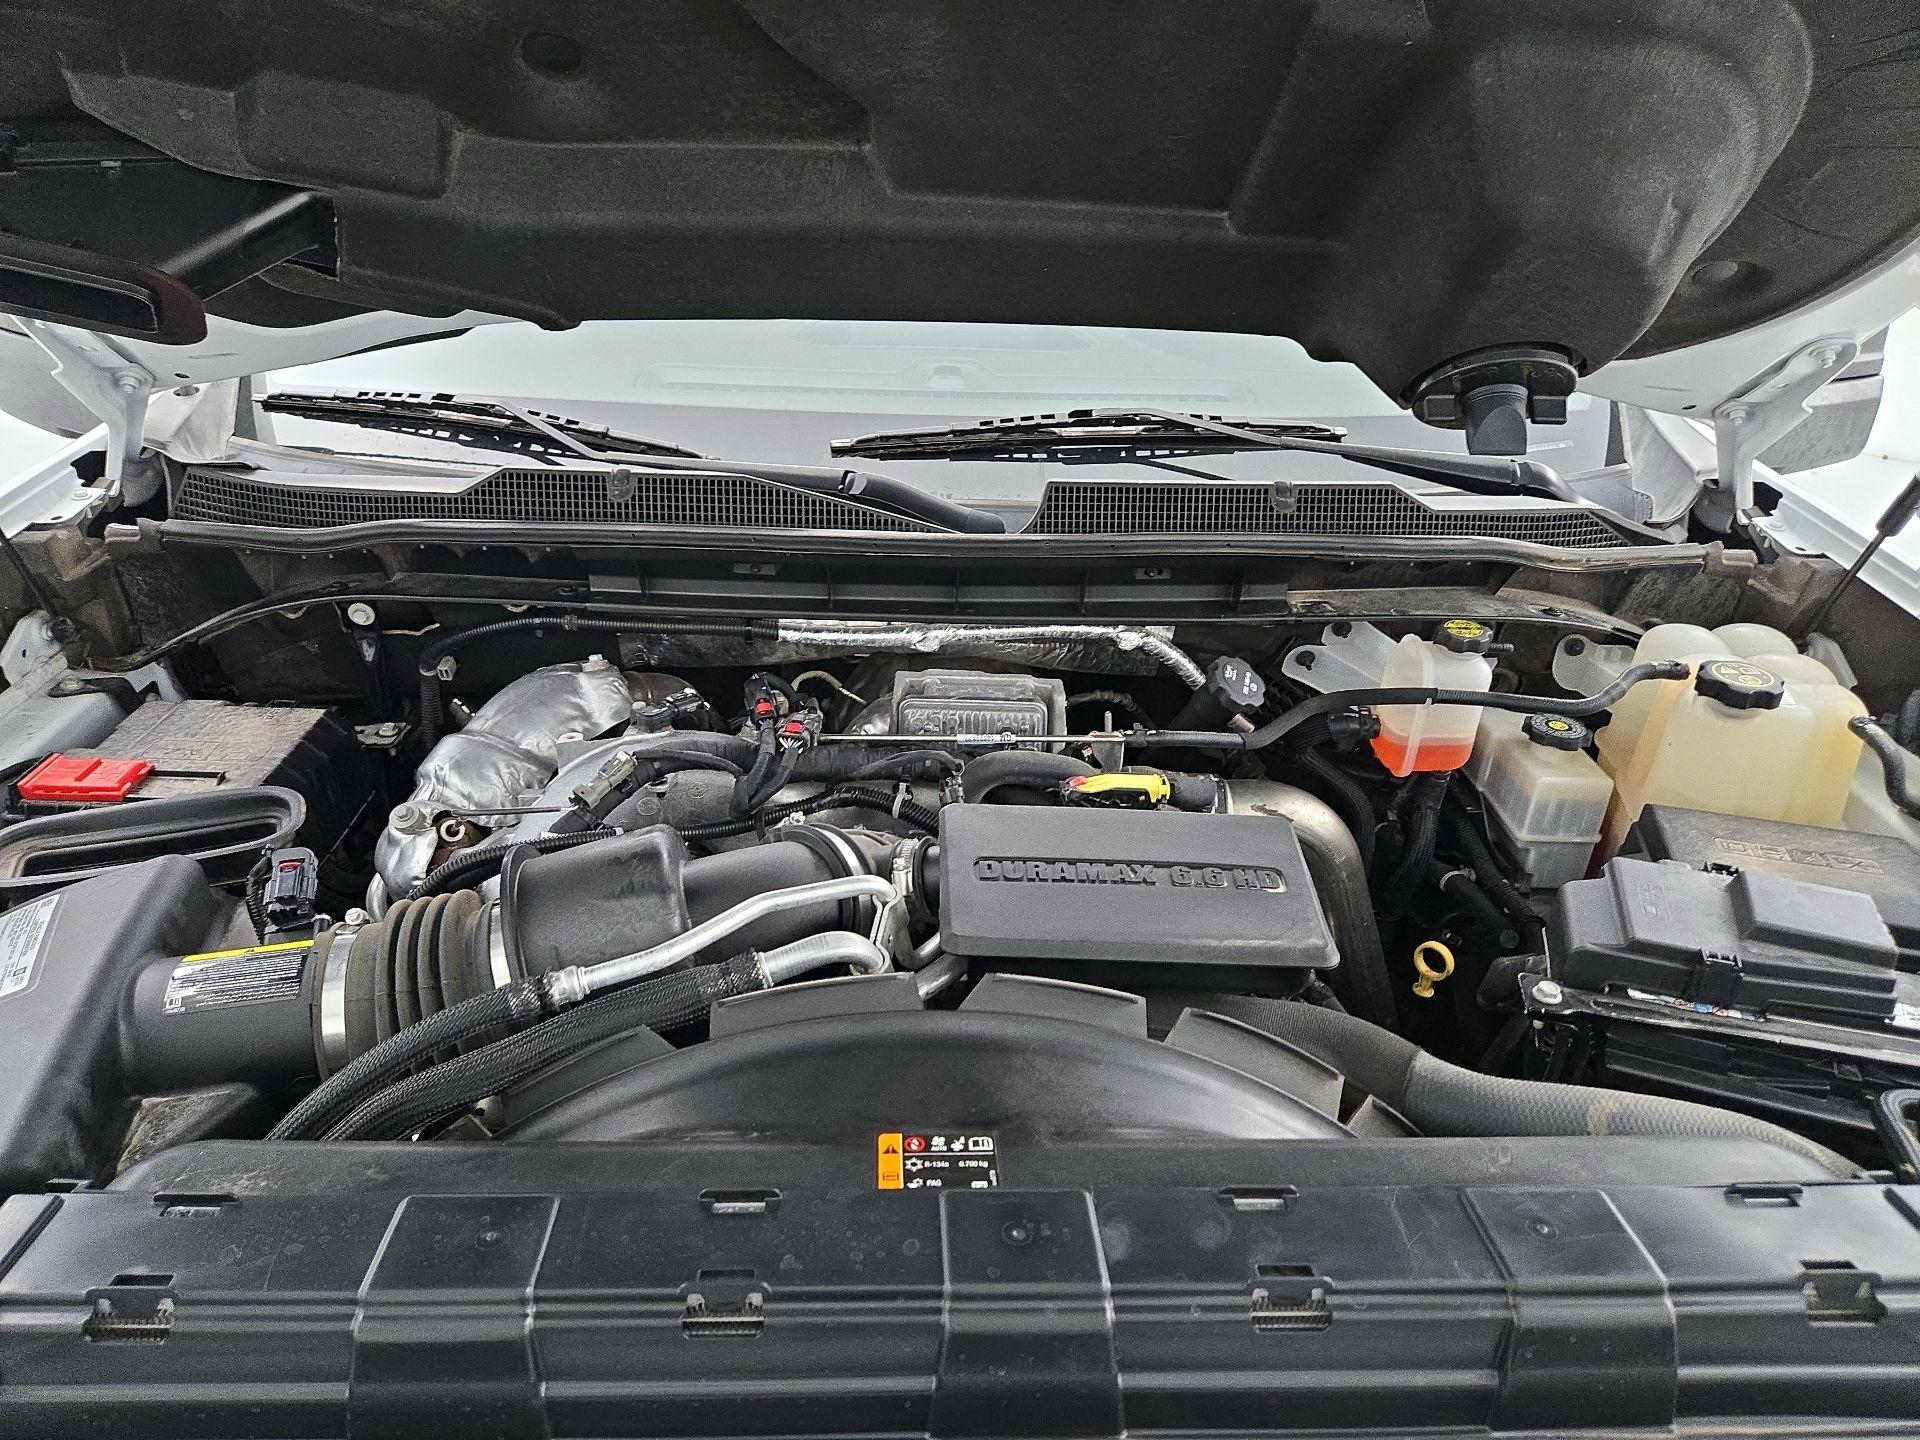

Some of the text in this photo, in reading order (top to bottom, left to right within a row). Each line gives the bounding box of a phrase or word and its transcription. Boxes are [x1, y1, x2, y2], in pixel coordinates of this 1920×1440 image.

[978, 859, 1283, 891] DURAMAX 6.6 HD
